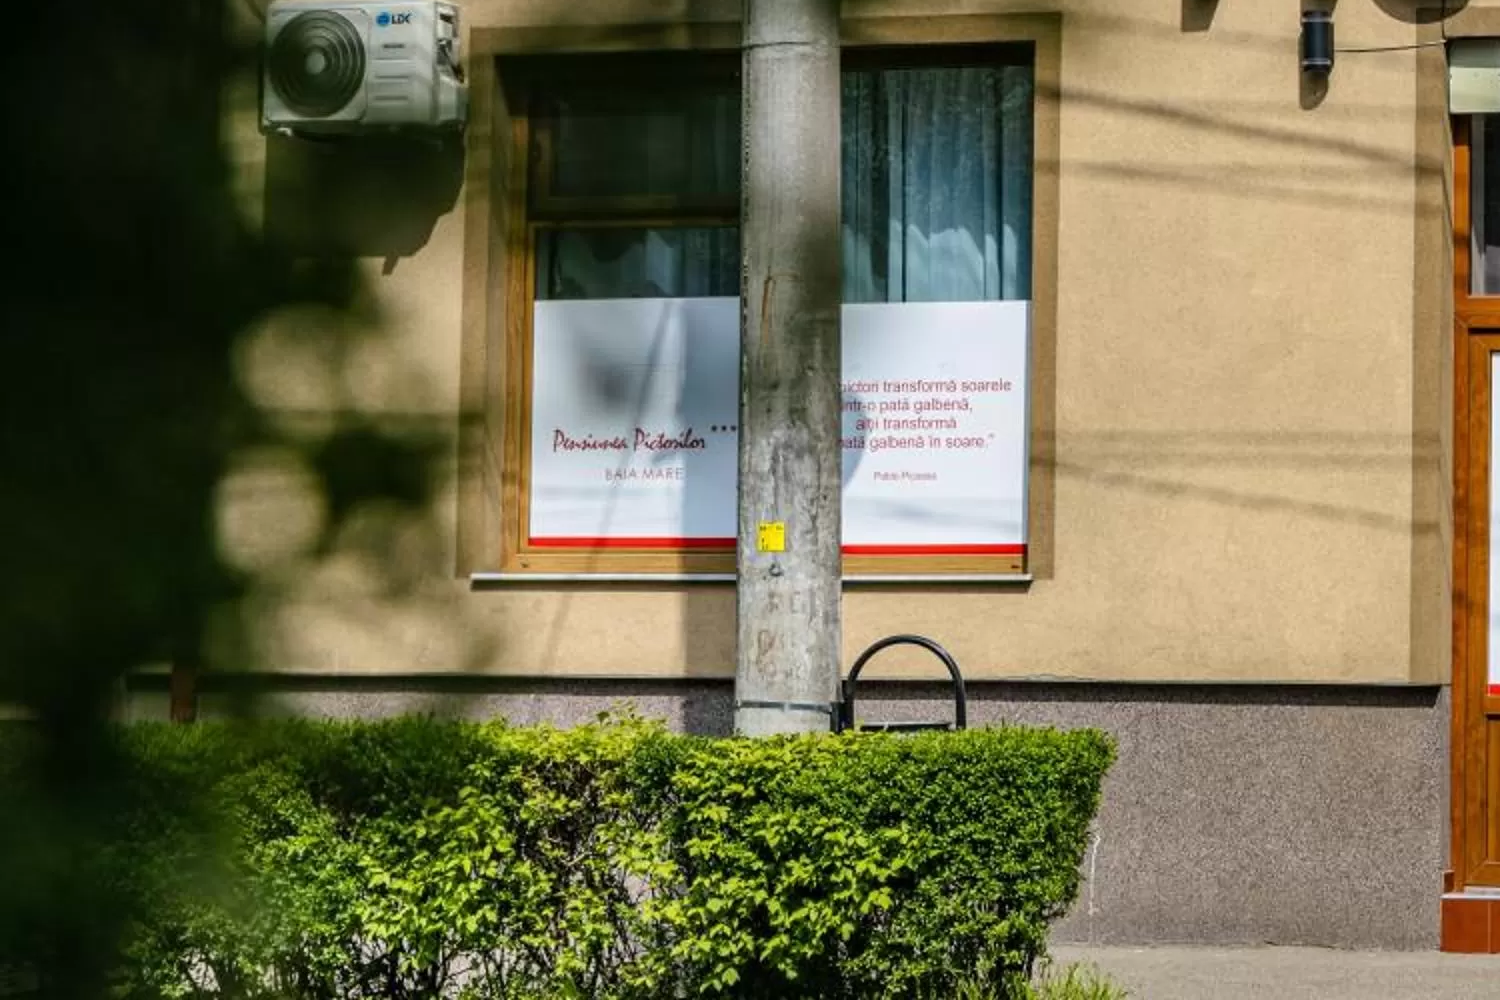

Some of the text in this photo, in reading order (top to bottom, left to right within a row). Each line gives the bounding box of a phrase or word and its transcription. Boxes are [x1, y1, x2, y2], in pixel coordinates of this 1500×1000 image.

[961, 378, 1013, 392] soarele
[553, 428, 629, 452] Pensiunea
[842, 436, 865, 449] ată
[604, 467, 638, 482] BAIA
